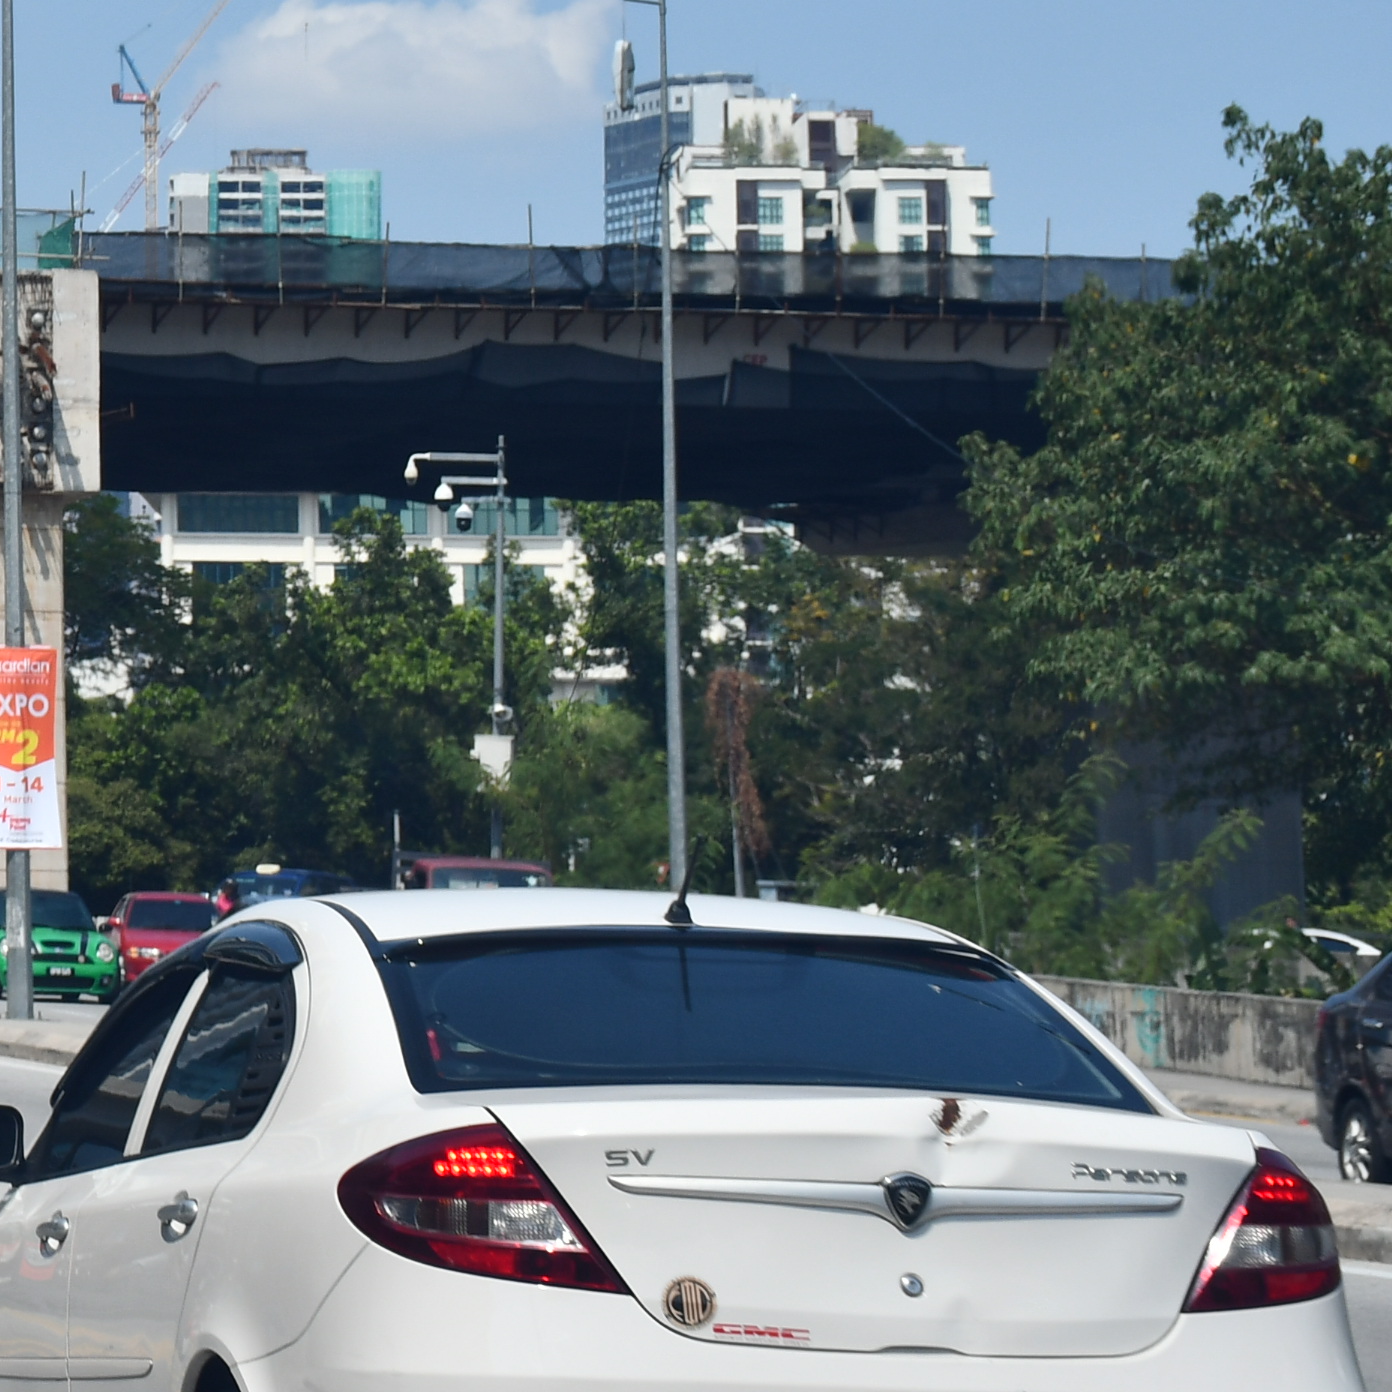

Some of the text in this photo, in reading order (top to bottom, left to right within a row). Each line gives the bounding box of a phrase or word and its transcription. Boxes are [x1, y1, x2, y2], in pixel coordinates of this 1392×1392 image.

[21, 776, 44, 793] 14
[4, 795, 33, 804] March
[605, 1149, 655, 1167] SV
